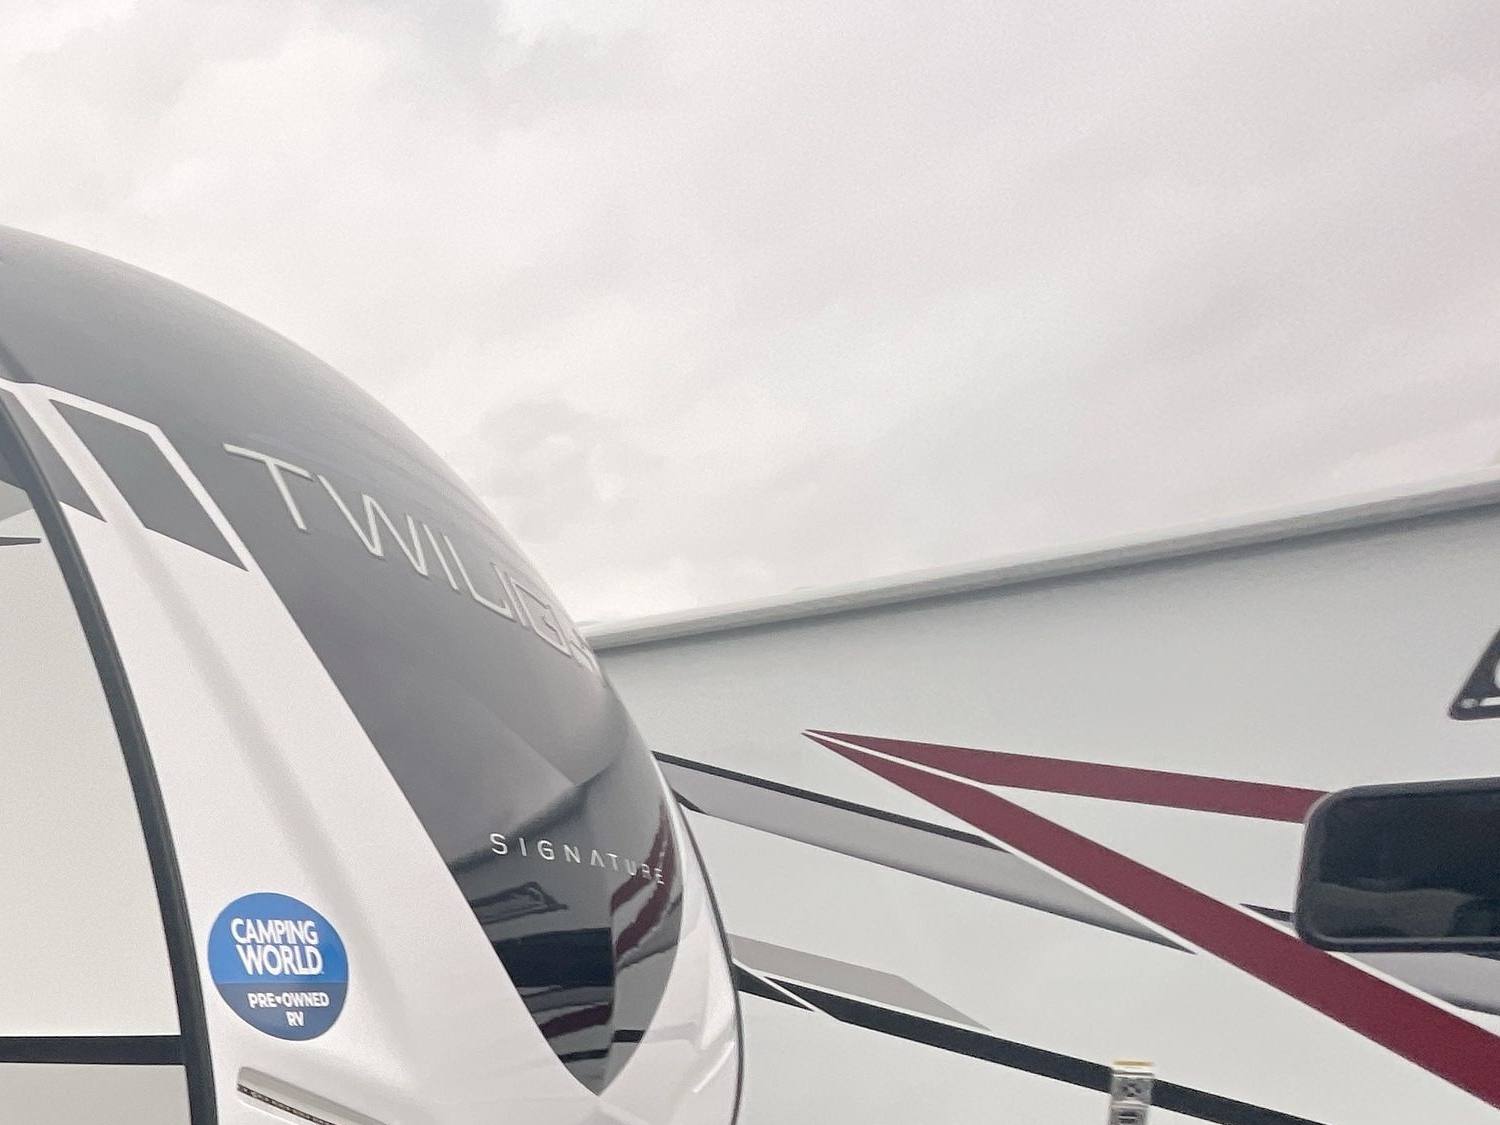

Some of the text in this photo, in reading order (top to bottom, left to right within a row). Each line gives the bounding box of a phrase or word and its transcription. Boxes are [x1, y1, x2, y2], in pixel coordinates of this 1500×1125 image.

[489, 832, 665, 885] SIGNATURE
[230, 917, 319, 944] CAMPING
[235, 945, 323, 975] WORLD
[285, 1011, 304, 1026] RV
